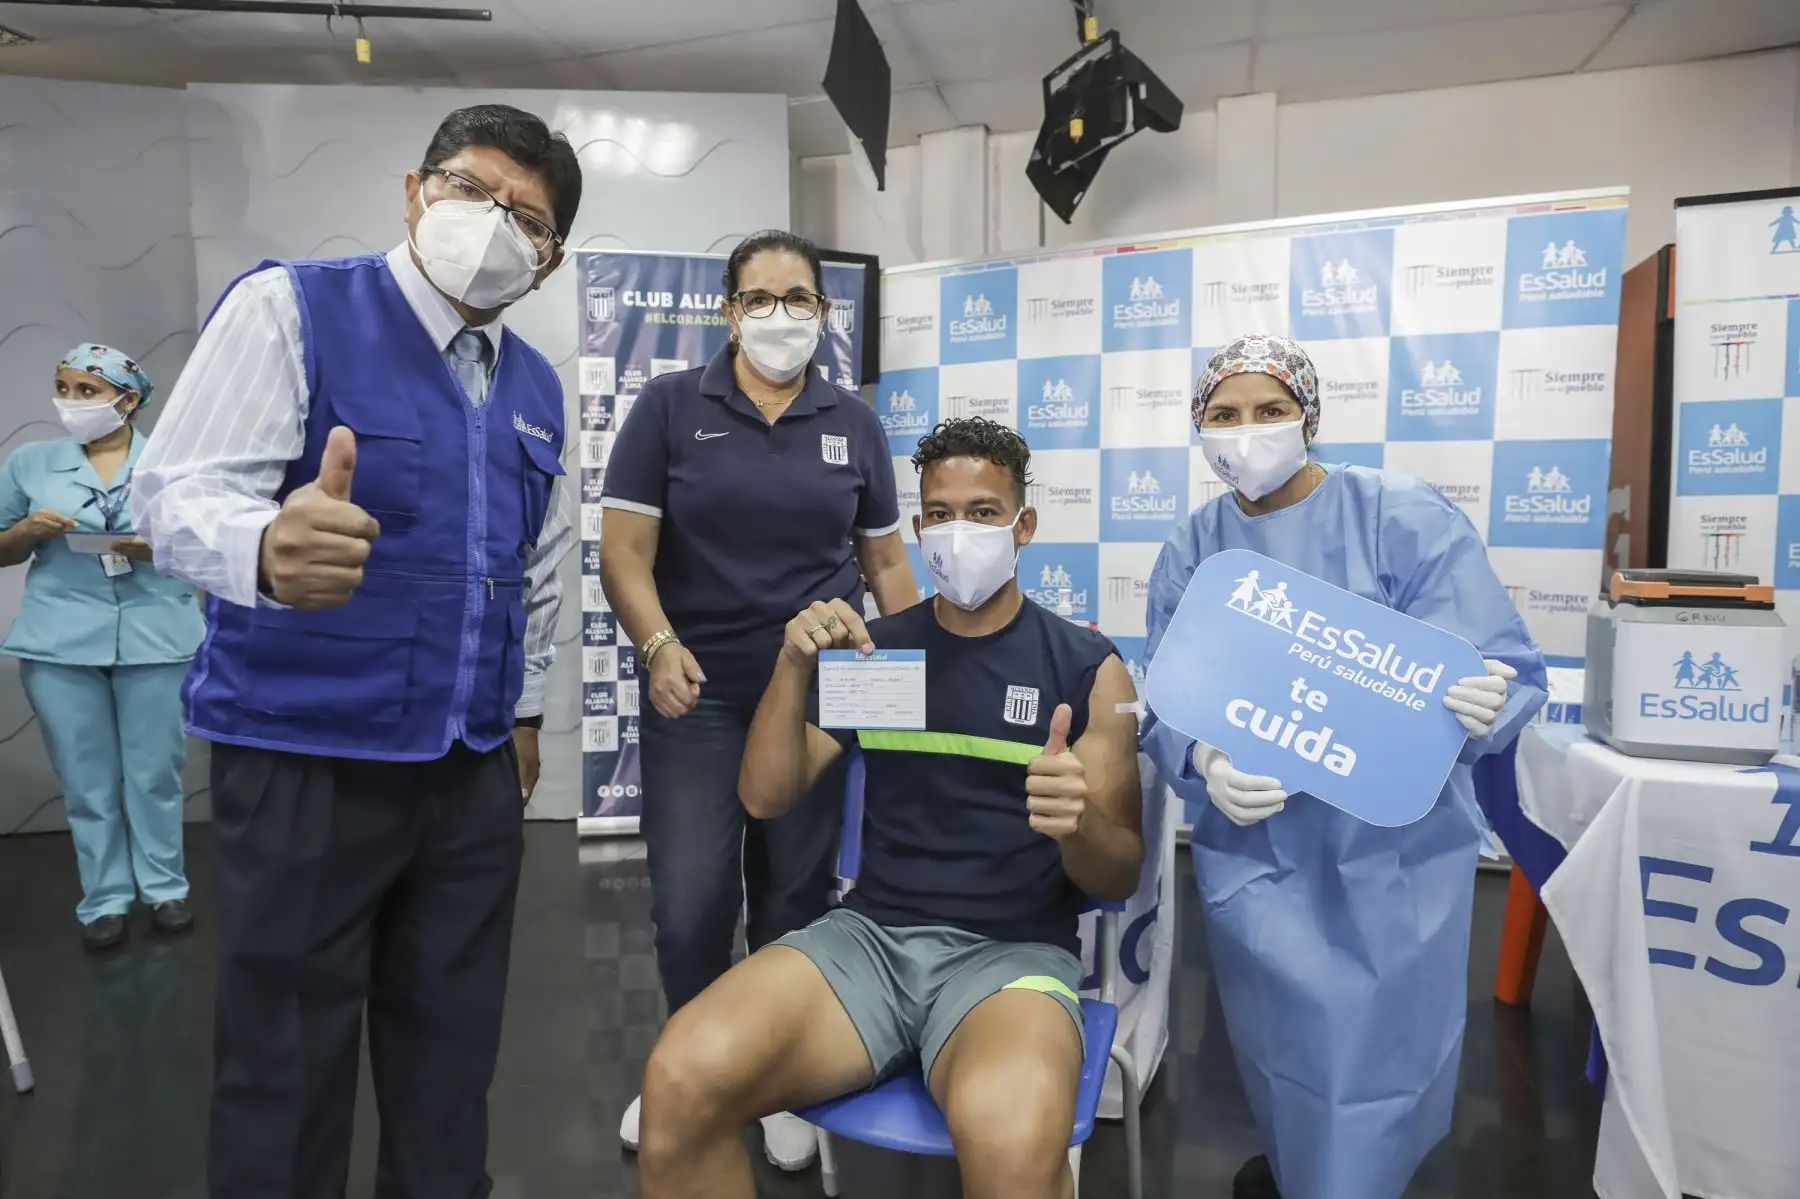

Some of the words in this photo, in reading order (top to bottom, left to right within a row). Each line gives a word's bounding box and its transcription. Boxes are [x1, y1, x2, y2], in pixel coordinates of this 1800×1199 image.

[1436, 265, 1494, 279] Siempre
[1519, 267, 1607, 292] EsSalud
[622, 290, 674, 308] CLUB
[679, 293, 725, 310] ALIA
[1050, 298, 1095, 310] Siempre
[1302, 284, 1378, 307] EsSalud
[1113, 300, 1180, 321] EsSalud
[896, 315, 933, 327] Siempre
[949, 314, 1008, 336] EsSalud
[1710, 322, 1758, 334] Siempre
[1326, 380, 1378, 393] Siempre
[1544, 371, 1605, 385] Siempre
[968, 397, 1010, 409] Siempre
[1136, 389, 1183, 401] Siempre
[1401, 387, 1482, 408] EsSalud
[1028, 401, 1089, 420] EsSalud
[1688, 446, 1767, 466] EsSalud
[1048, 486, 1092, 498] Siempre
[1111, 495, 1177, 512] EsSalud
[1505, 495, 1591, 514] EsSalud
[1700, 513, 1747, 524] Siempre
[1529, 590, 1588, 604] Siempre
[1295, 610, 1446, 694] EsSalud
[1287, 642, 1333, 670] Perú
[1332, 663, 1427, 712] saludable
[1289, 676, 1329, 713] te
[1639, 692, 1770, 723] EsSalud
[1224, 698, 1357, 777] cuida
[1638, 855, 1800, 986] ES
